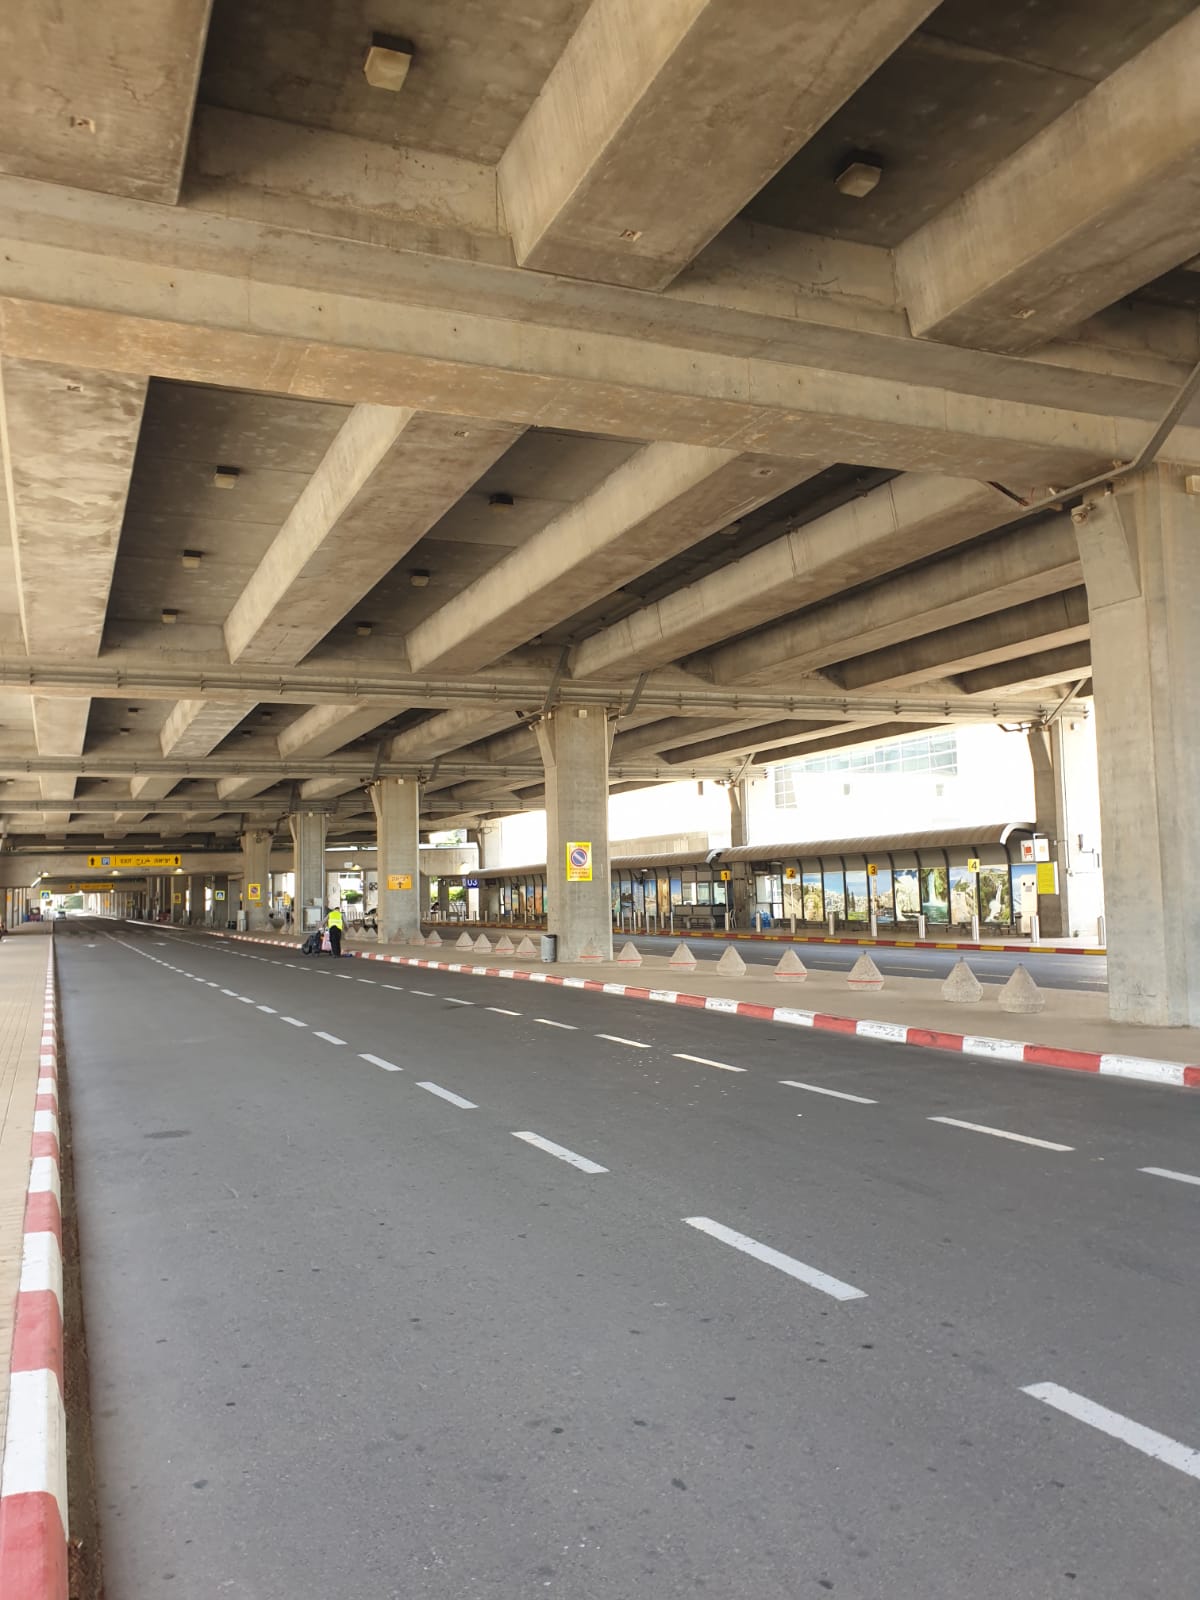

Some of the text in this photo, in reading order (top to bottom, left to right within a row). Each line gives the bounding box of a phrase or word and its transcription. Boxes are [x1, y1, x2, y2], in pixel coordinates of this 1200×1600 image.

[870, 865, 876, 874] 3
[971, 861, 977, 870] 4
[789, 869, 795, 877] 2
